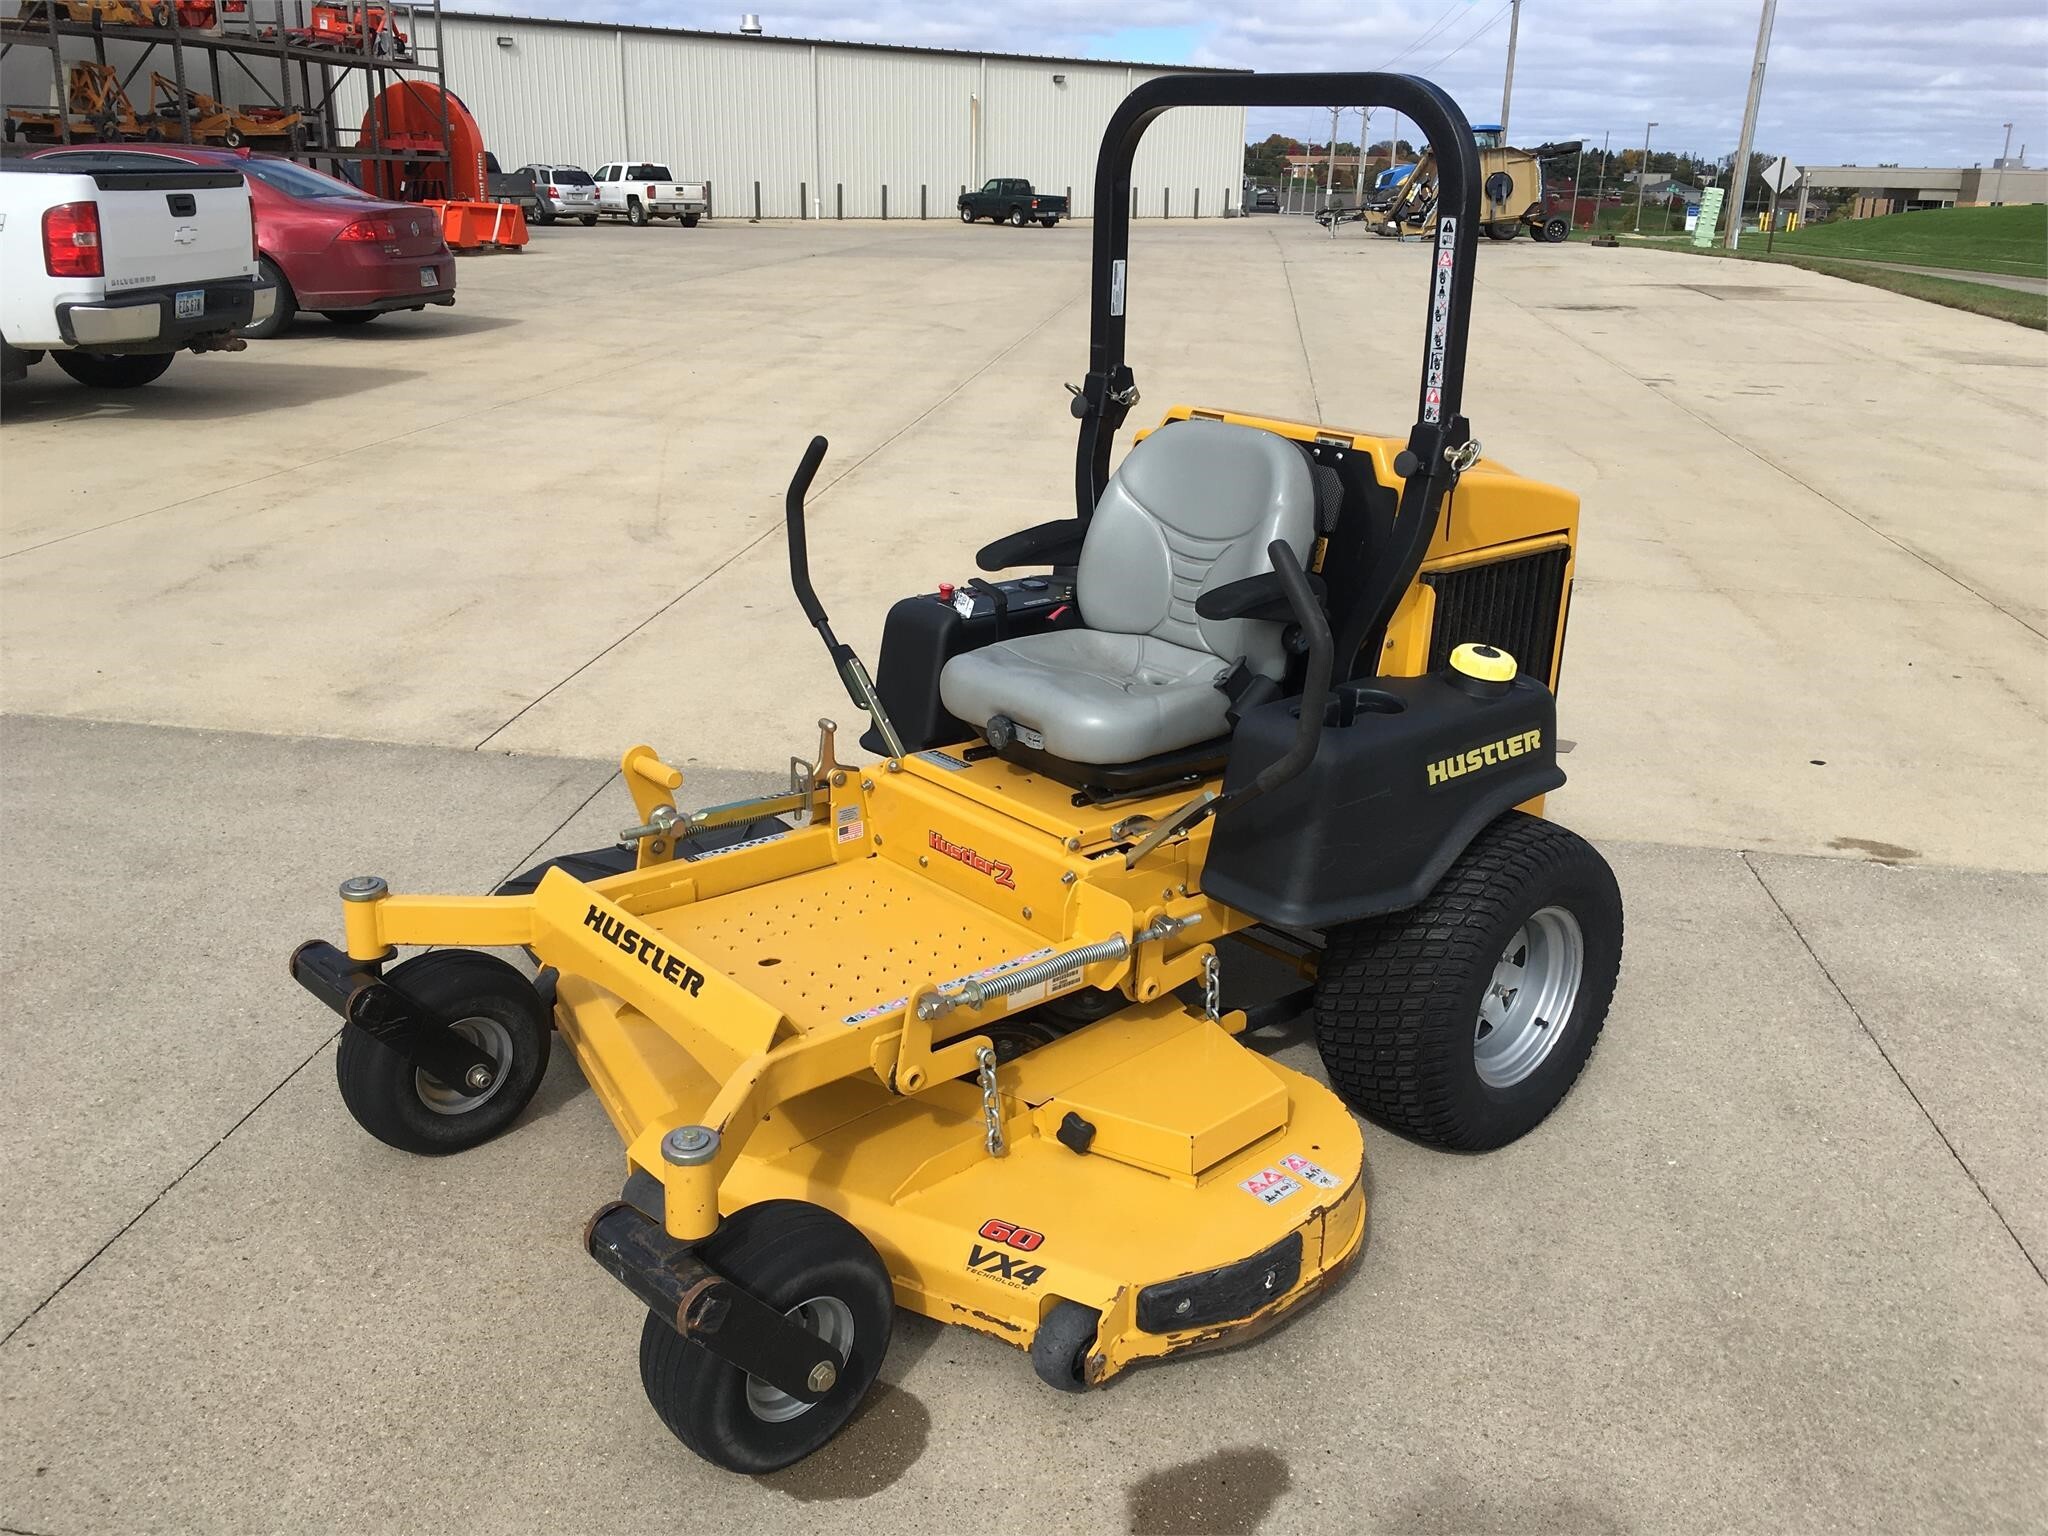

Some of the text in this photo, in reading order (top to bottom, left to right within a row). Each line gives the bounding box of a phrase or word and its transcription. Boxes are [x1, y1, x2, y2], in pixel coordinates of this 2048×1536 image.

[1426, 729, 1541, 786] HUSTLER
[929, 830, 994, 876] Hustler
[583, 904, 705, 998] HUSTLER
[978, 1218, 1045, 1252] 60
[965, 1266, 1029, 1291] TECHNOLOGY
[967, 1244, 1047, 1286] VX4
